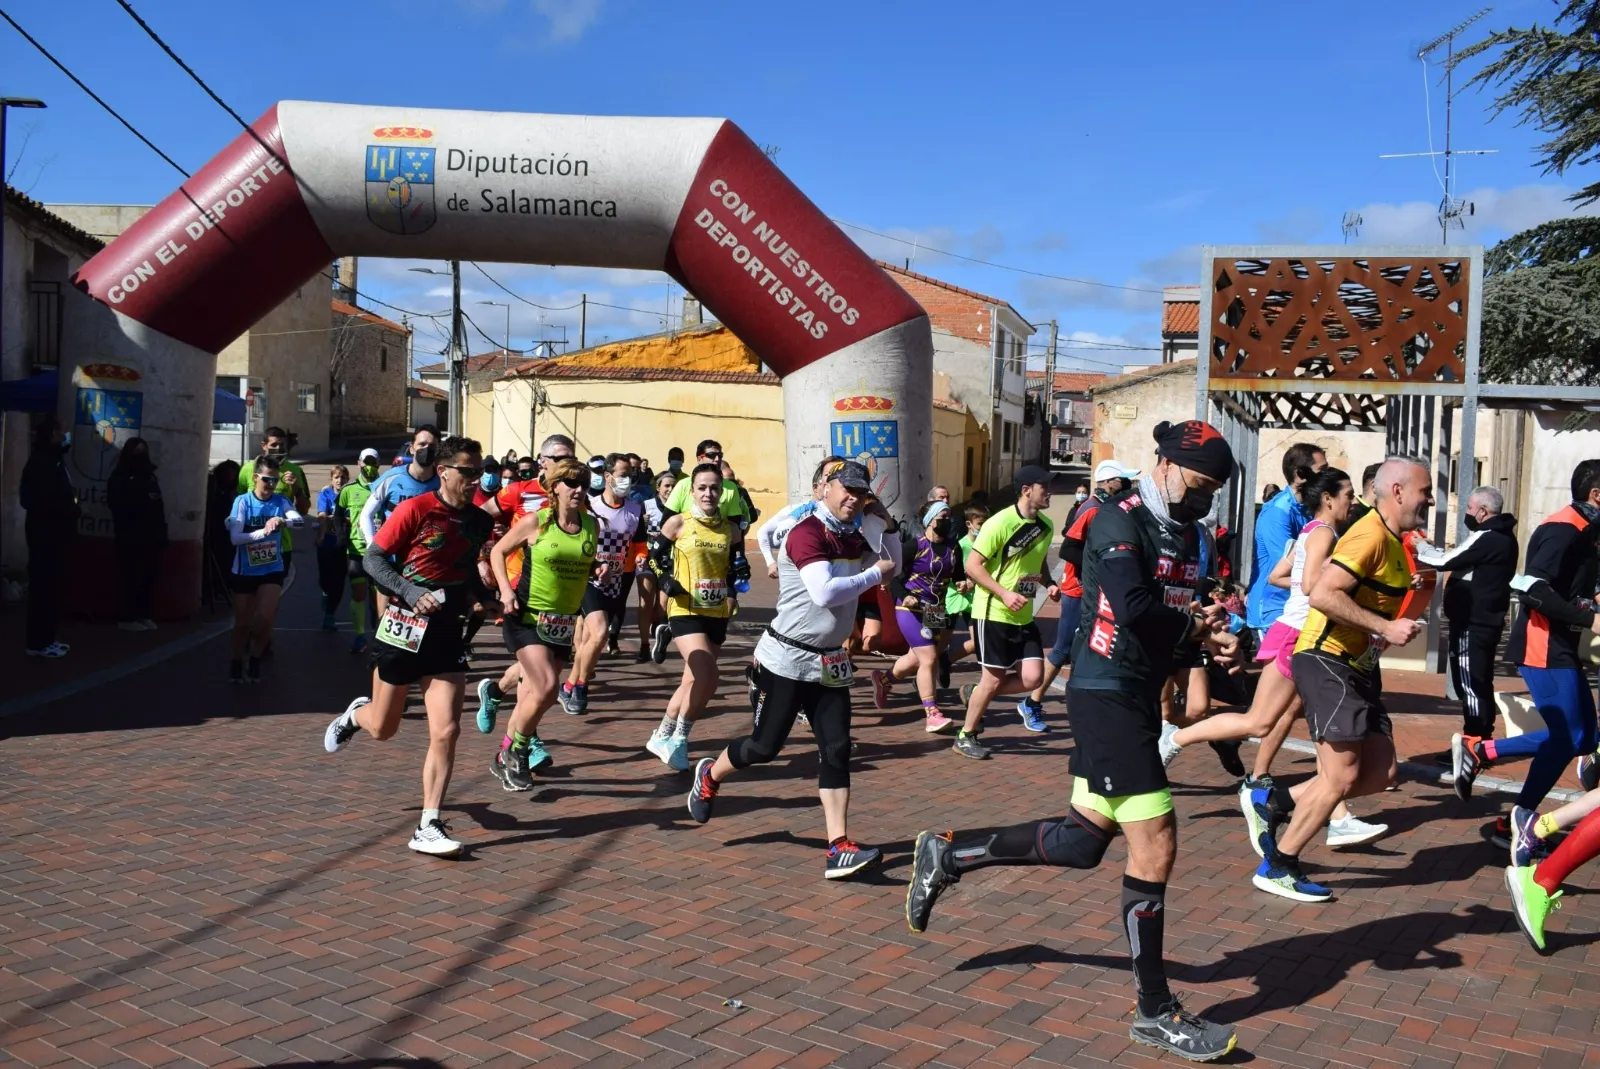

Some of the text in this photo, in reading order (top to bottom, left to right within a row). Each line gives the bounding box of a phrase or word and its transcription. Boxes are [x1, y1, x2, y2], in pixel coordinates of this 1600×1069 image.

[447, 148, 589, 178] Diputación
[447, 188, 617, 218] de Salamanca
[107, 156, 285, 304] CON EL DEPORTE
[709, 179, 860, 326] CON NUESTROS
[694, 208, 829, 339] DEPORTISTAS
[254, 549, 273, 560] 336
[702, 589, 722, 601] 364
[385, 619, 413, 640] 331
[544, 625, 568, 638] 369
[1091, 625, 1111, 654] DT
[831, 663, 850, 679] 39
